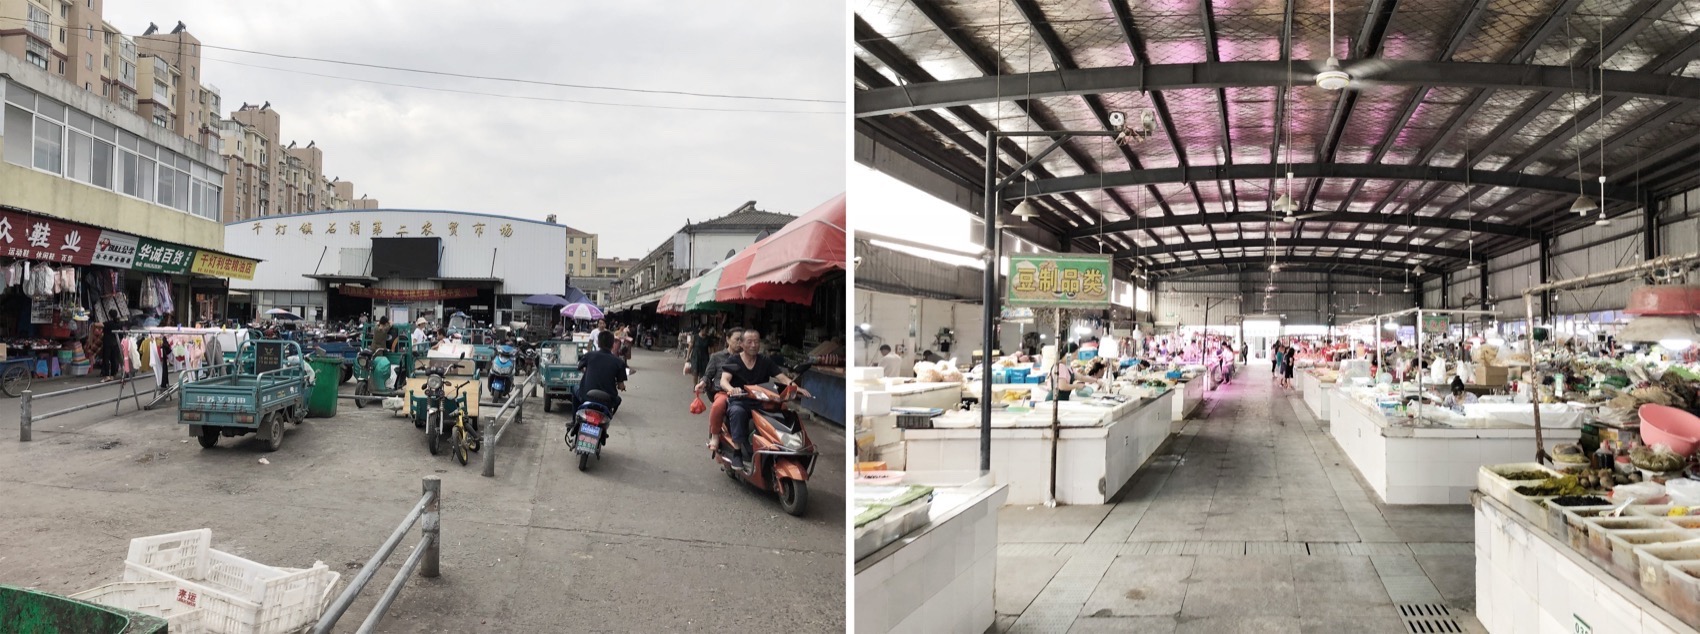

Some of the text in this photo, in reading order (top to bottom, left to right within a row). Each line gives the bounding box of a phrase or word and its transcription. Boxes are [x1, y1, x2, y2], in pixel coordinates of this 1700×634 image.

[8, 247, 30, 258] 运动鞋
[138, 243, 184, 266] 华诚百货
[201, 254, 253, 274] 千灯利宏粮油店
[1017, 268, 1103, 294] 豆制品类
[1575, 622, 1589, 634] 03
